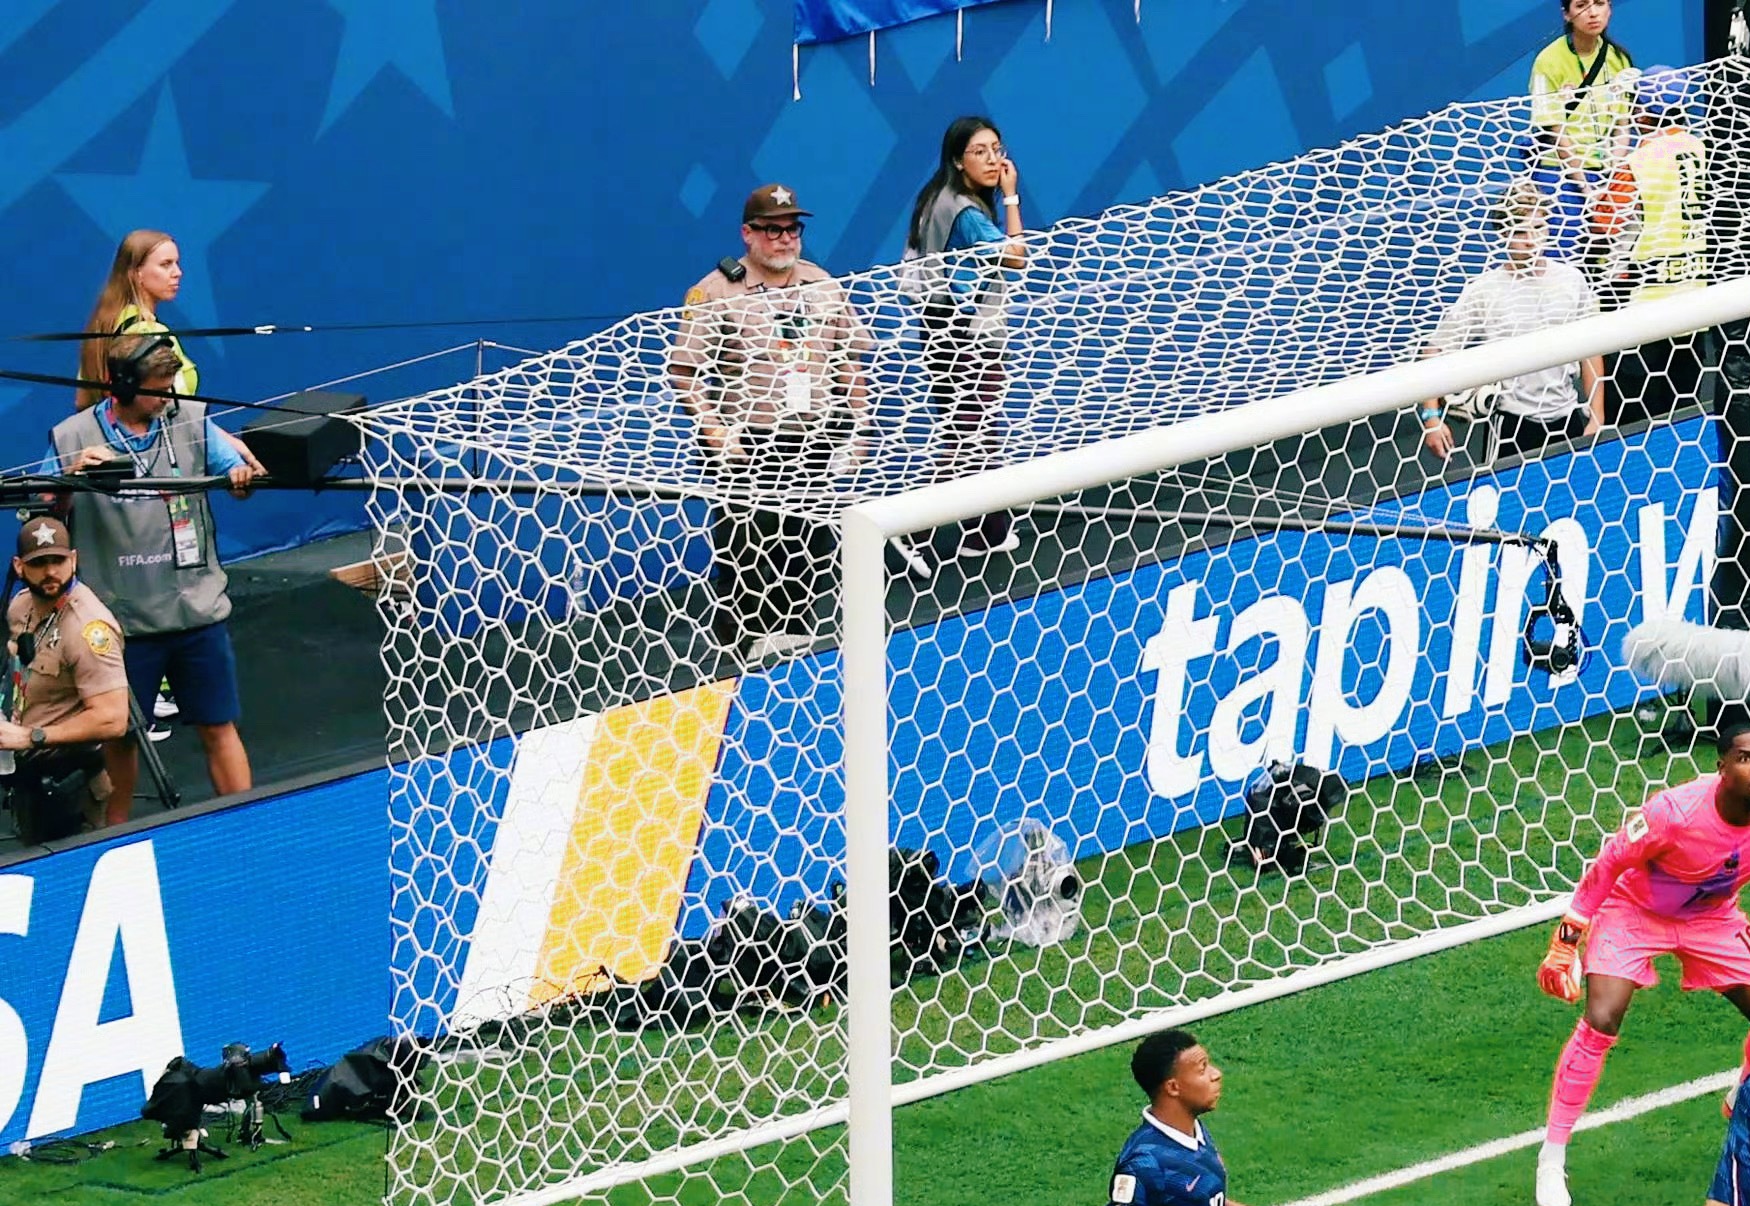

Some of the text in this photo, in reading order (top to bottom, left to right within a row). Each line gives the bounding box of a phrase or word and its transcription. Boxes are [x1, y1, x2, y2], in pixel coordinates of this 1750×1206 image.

[117, 552, 172, 567] FIFA.com
[1141, 565, 1420, 799] tap
[1443, 485, 1589, 719] in
